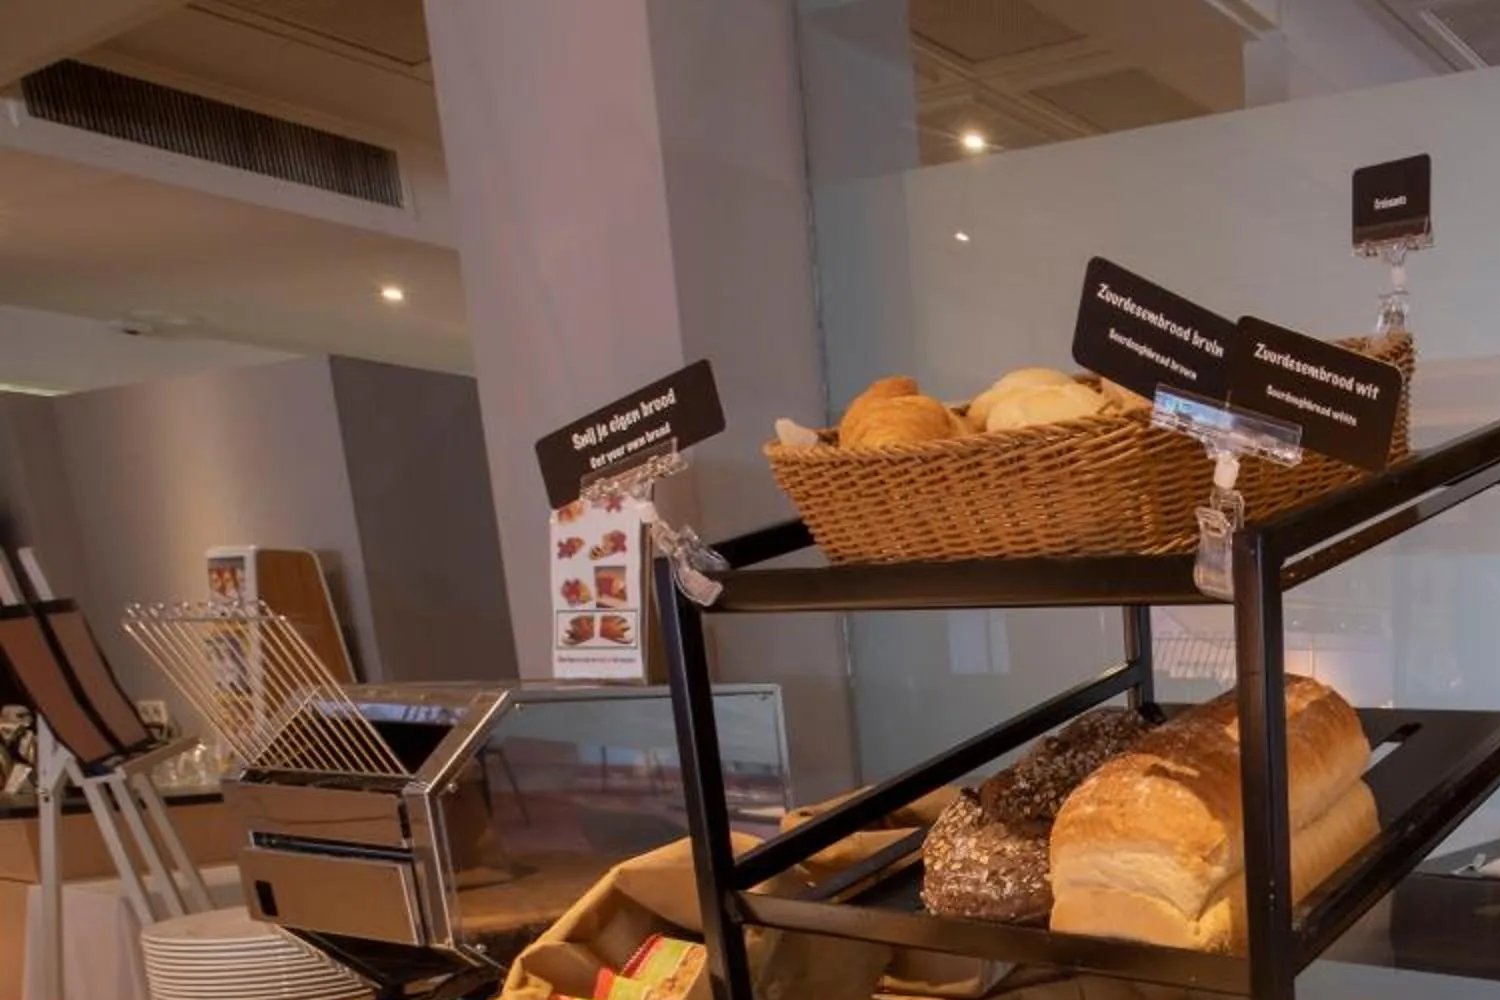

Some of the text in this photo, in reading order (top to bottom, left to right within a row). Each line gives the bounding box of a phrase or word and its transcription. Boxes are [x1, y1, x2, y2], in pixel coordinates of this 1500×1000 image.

[1191, 330, 1225, 358] bruin
[1355, 381, 1380, 400] wit
[572, 387, 676, 450] Snij je eigen brood
[606, 445, 625, 463] your
[626, 435, 645, 453] own
[645, 421, 671, 442] bread
